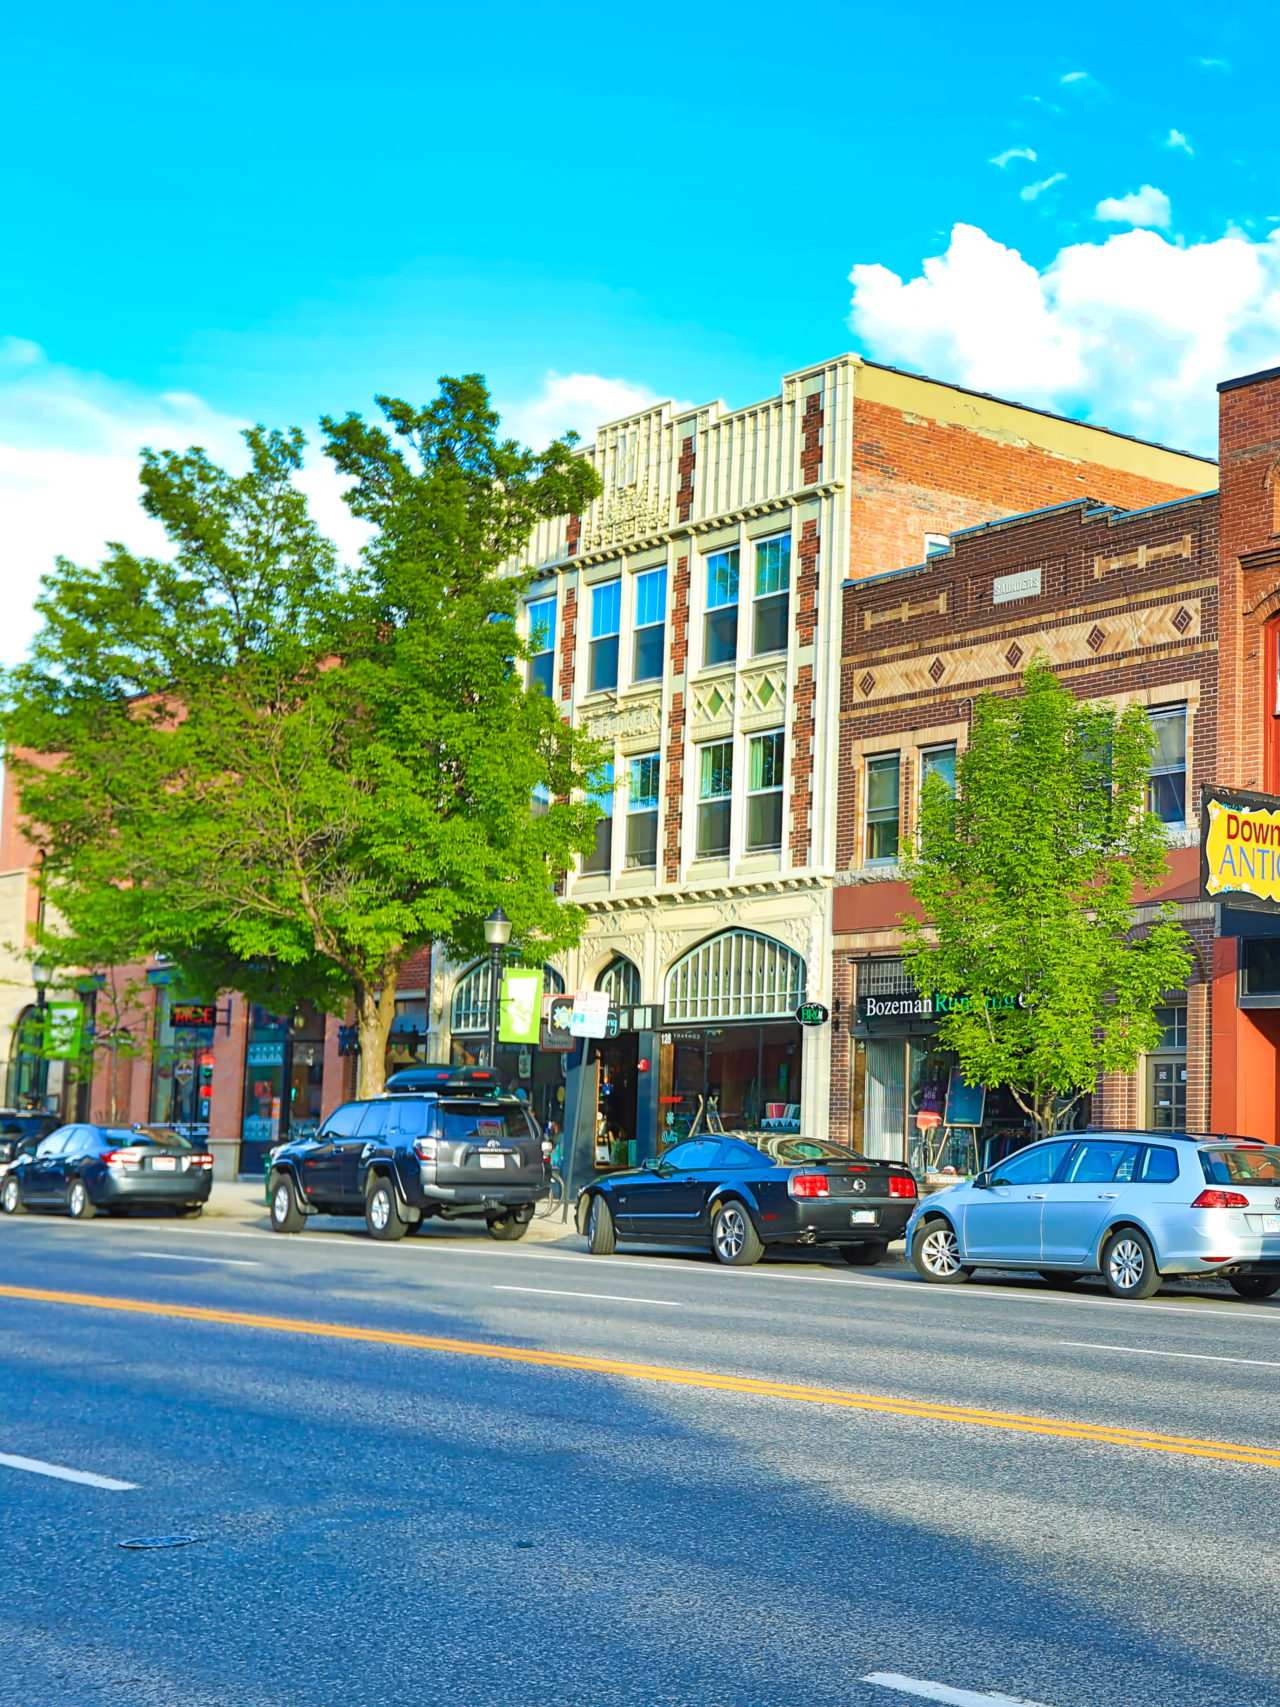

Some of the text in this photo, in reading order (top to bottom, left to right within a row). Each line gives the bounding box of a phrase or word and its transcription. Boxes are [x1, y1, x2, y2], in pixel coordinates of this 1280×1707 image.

[994, 576, 1039, 596] SAUNDERS
[866, 998, 932, 1017] Bozeman
[935, 991, 1015, 1013] Runing
[661, 1032, 672, 1045] 128
